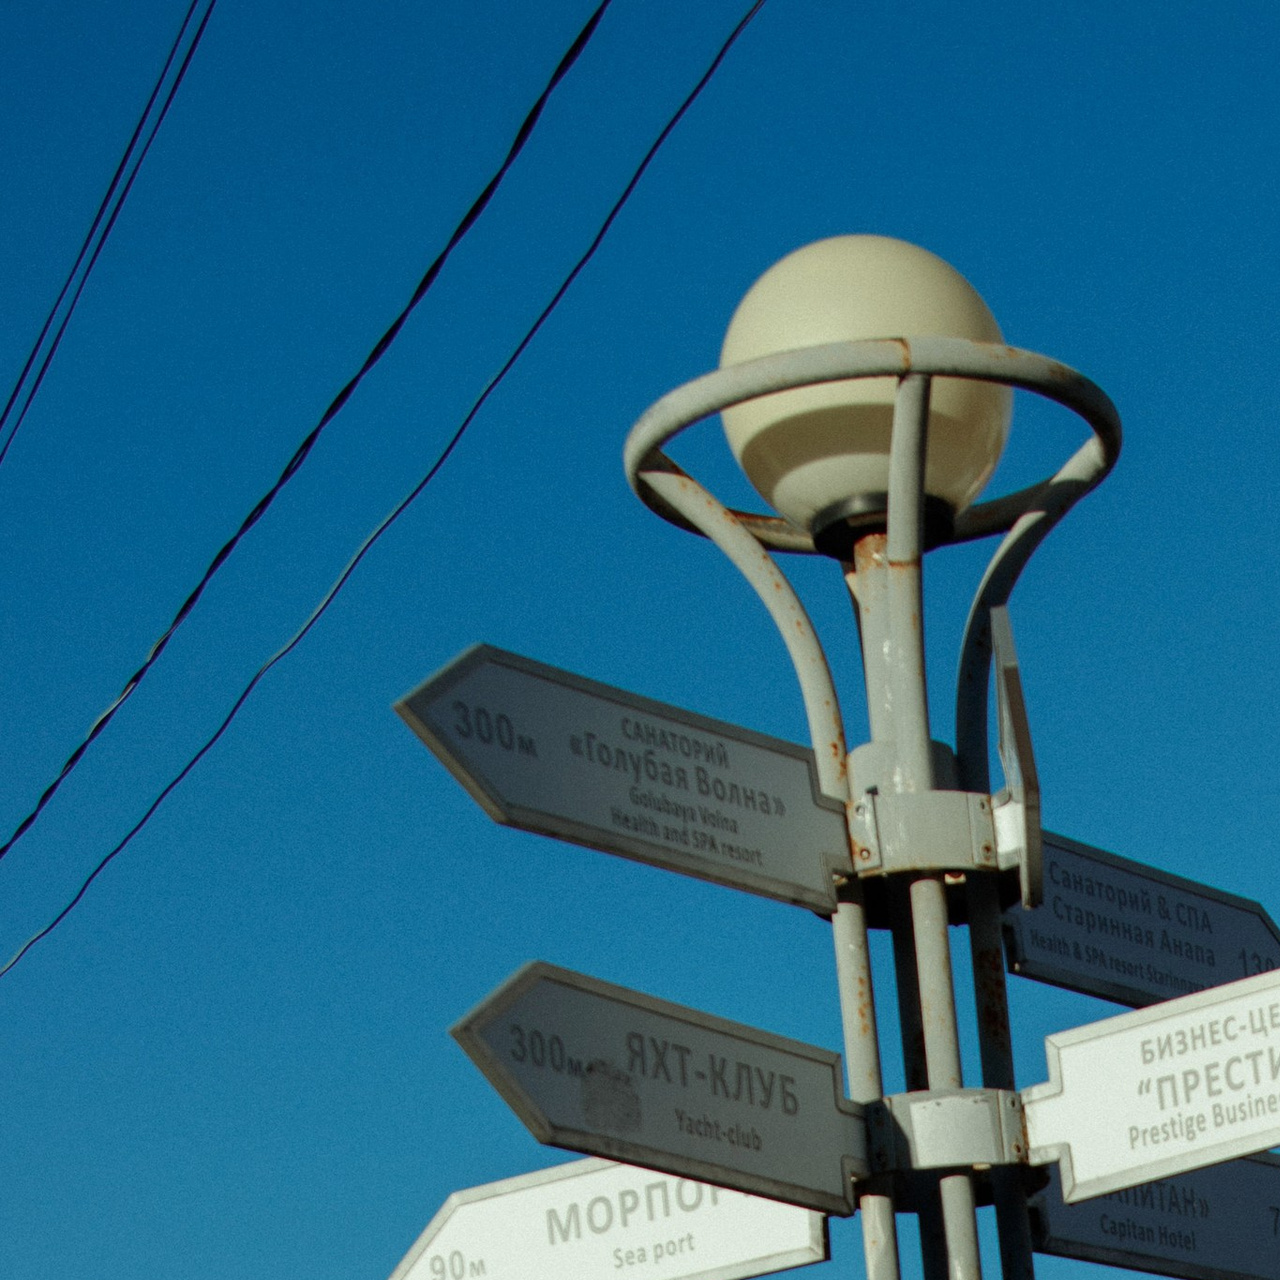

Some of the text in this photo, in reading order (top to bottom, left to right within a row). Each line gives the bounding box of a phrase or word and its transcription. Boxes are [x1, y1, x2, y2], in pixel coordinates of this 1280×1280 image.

[453, 700, 538, 758] 300м
[621, 718, 730, 769] САНАТОРИЙ
[569, 731, 786, 817] «Голубая Волна»
[610, 806, 763, 866] Health and SPA resort
[1048, 861, 1213, 935] Санаторий & СПА
[1030, 929, 1070, 956] Health
[1073, 941, 1082, 960] &
[1085, 945, 1107, 969] SPA
[1110, 956, 1144, 979] resort
[1053, 896, 1216, 967] Старинная Анапа
[626, 1032, 799, 1116] ЯХТ-КЛУБ
[675, 1108, 762, 1152] Yacht-club
[1128, 1111, 1206, 1150] Prestige
[545, 1179, 748, 1246] МОРПО
[1100, 1213, 1196, 1250] Capitan Hotel
[613, 1232, 695, 1269] Sea port
